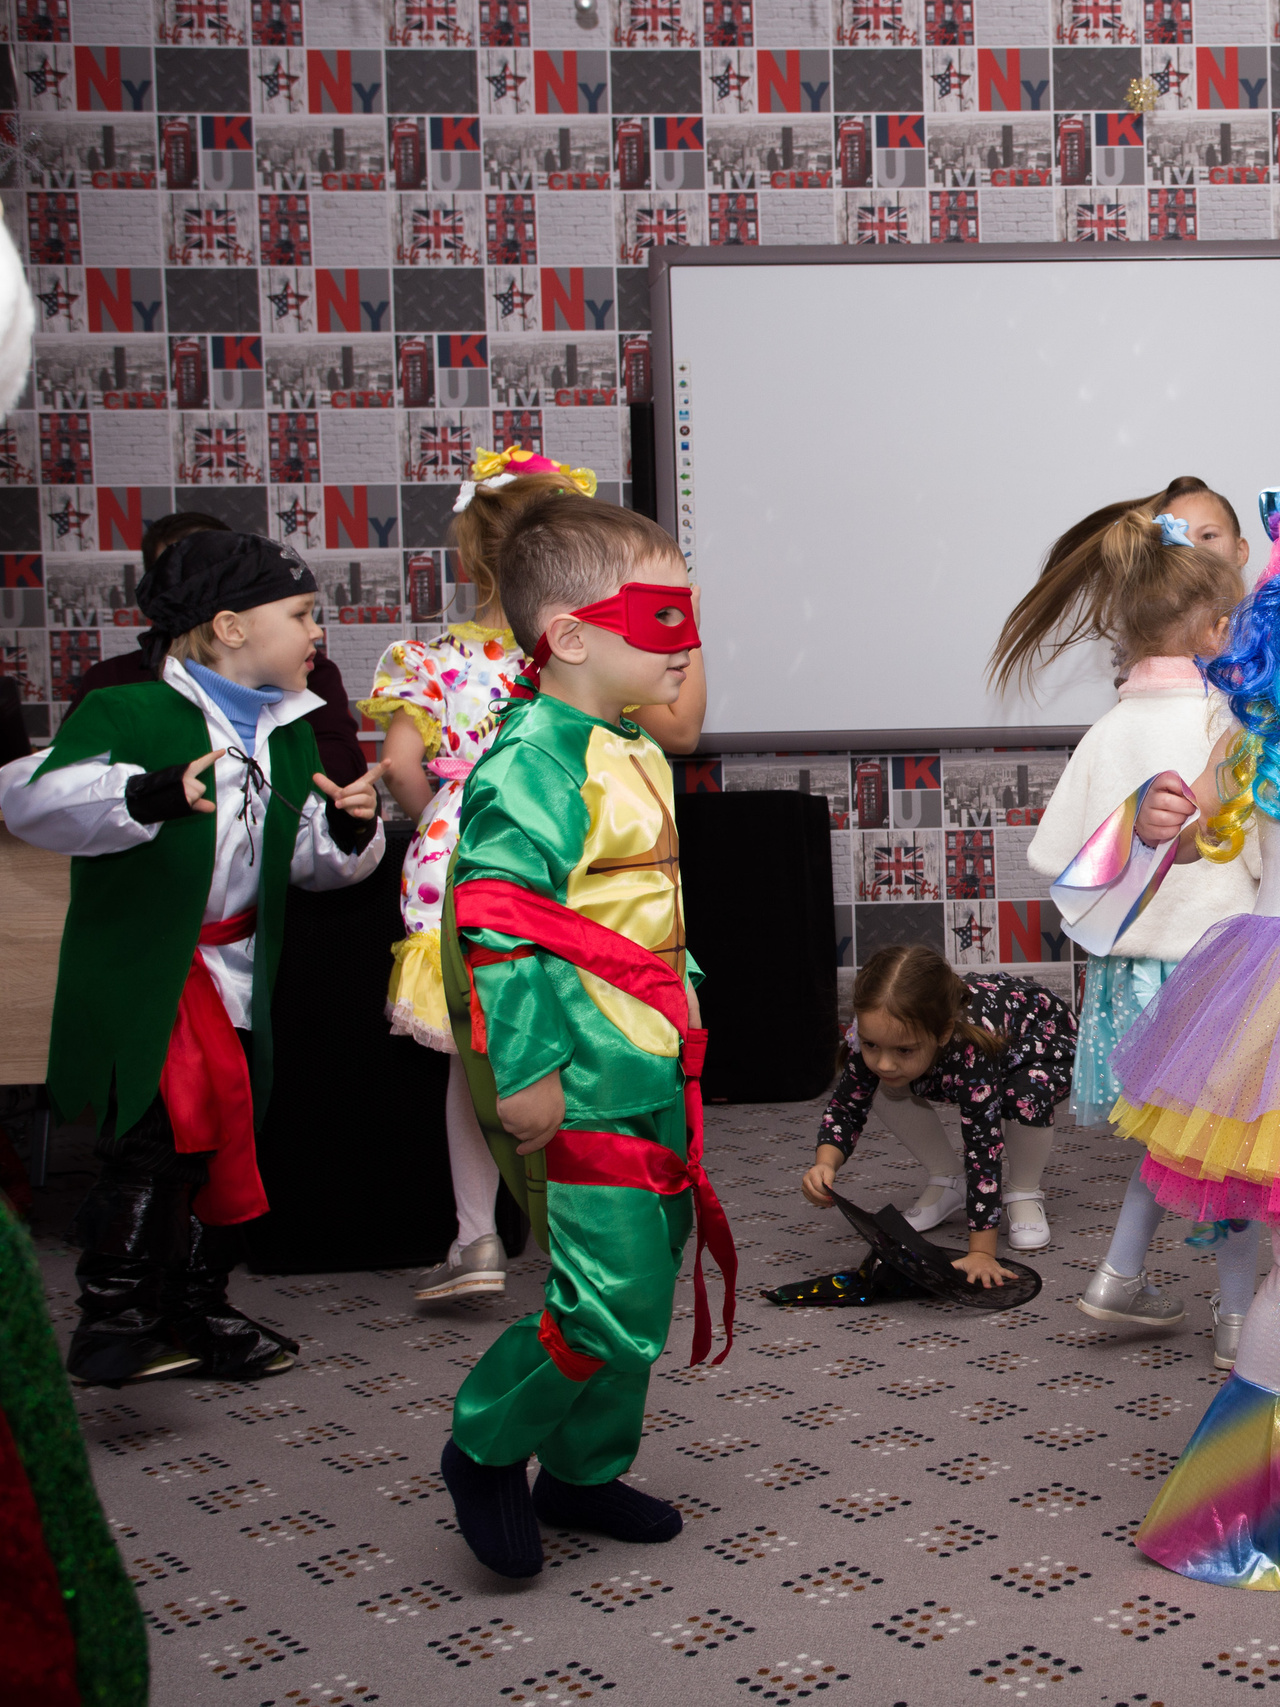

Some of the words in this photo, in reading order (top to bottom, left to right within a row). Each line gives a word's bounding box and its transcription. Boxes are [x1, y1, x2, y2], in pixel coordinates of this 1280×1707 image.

[210, 30, 218, 39] a
[438, 32, 447, 40] a
[663, 32, 672, 41] a
[886, 31, 894, 40] a
[1105, 30, 1113, 39] a
[220, 251, 228, 260] a
[447, 251, 455, 259] a
[229, 469, 237, 478] a
[455, 467, 463, 476] a
[96, 486, 147, 551] N
[907, 887, 915, 895] a
